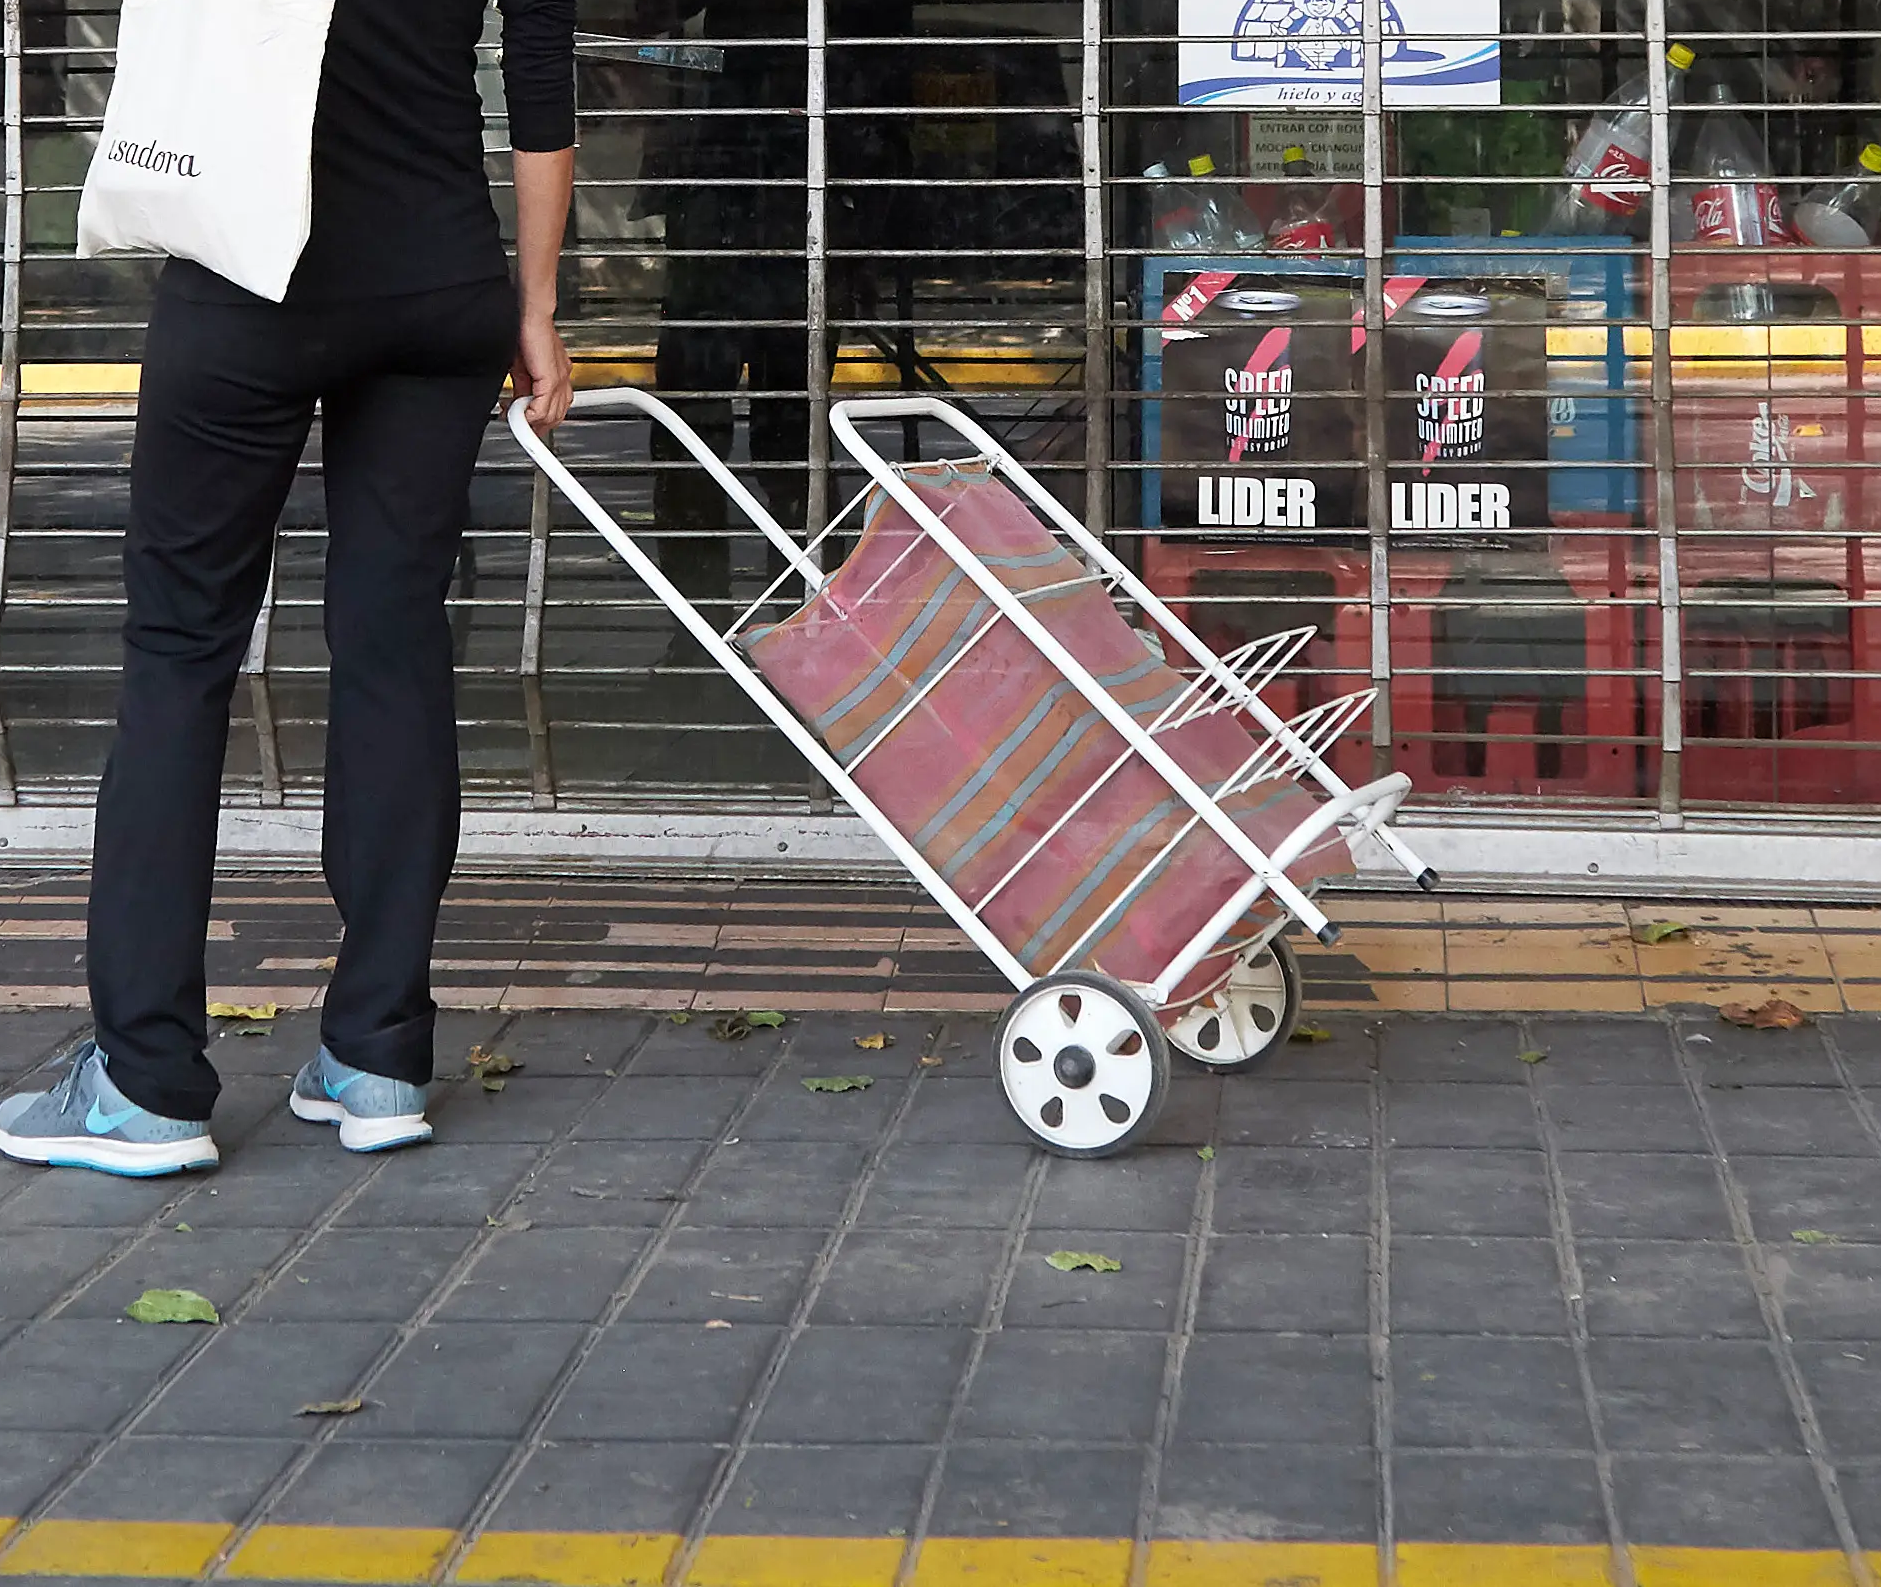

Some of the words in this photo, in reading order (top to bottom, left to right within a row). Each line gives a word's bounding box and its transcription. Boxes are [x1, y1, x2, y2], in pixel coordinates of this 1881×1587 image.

[1277, 87, 1320, 101] hielo
[1323, 90, 1336, 104] y
[1224, 367, 1293, 416] SPEED
[1415, 372, 1485, 421] SPEED
[1225, 411, 1291, 440] UNLIMITED
[1418, 417, 1483, 446] UNLIMITED
[1198, 475, 1316, 528] LIDER
[1390, 482, 1511, 529] LIDER
